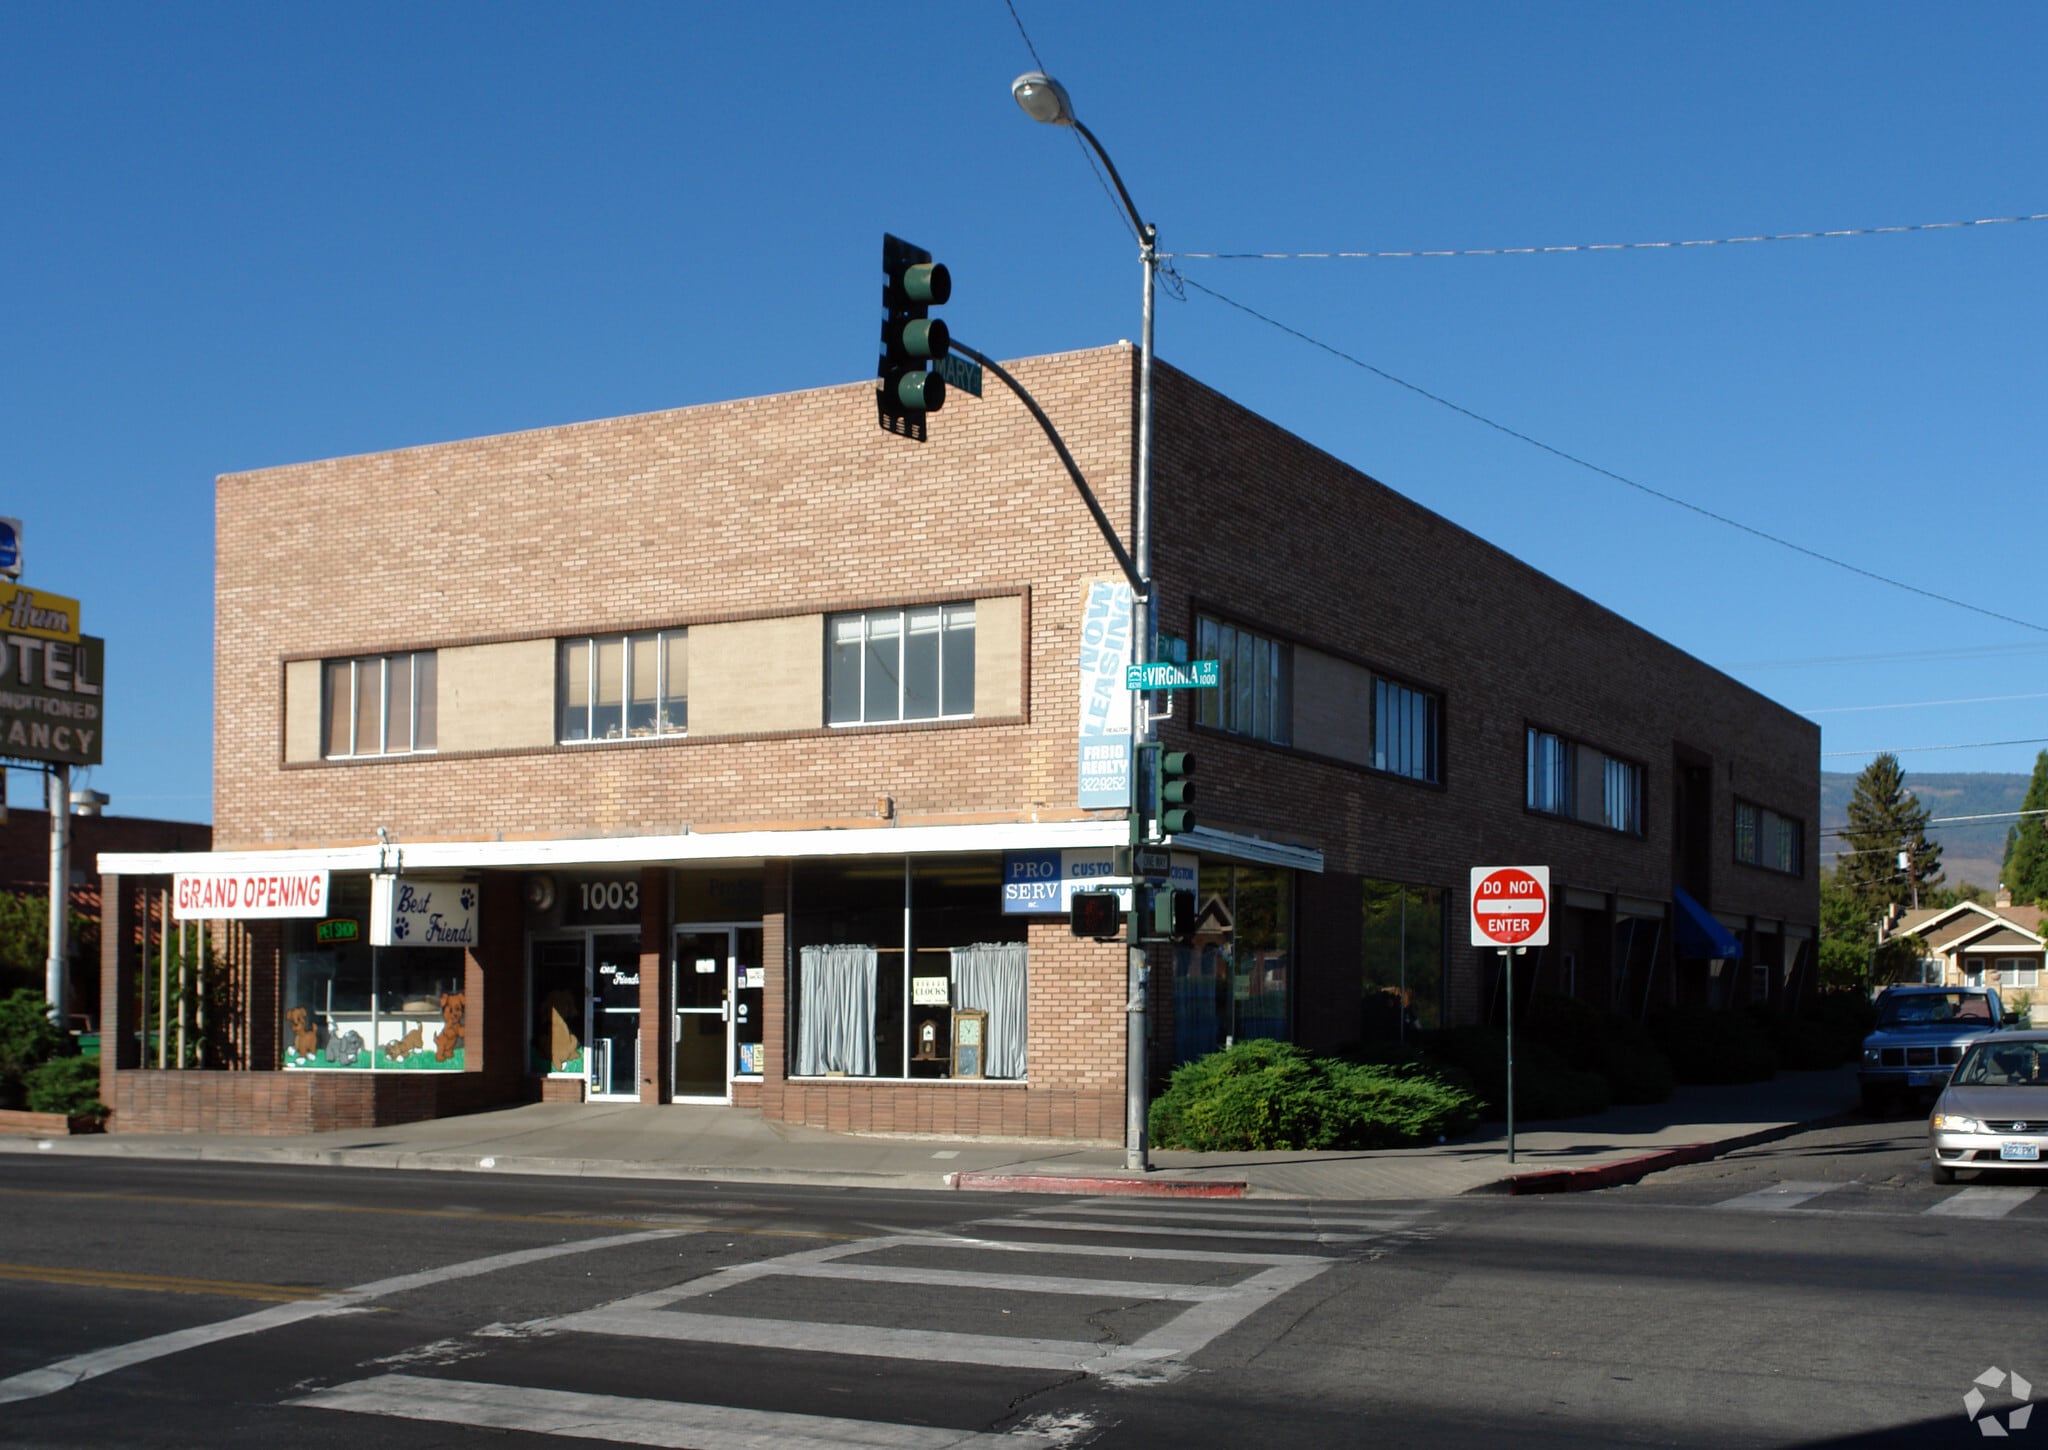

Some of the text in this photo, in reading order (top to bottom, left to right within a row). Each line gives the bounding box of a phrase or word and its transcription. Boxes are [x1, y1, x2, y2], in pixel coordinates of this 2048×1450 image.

[935, 355, 975, 392] MARY
[1080, 582, 1113, 672] NOW
[0, 634, 101, 696] TEL
[1084, 586, 1131, 736] LEASING
[1147, 664, 1199, 686] VIRGINIA
[1203, 662, 1212, 673] ST
[1200, 674, 1216, 685] 1000
[0, 719, 95, 755] ANCY
[1084, 744, 1124, 761] FABIO
[1082, 760, 1128, 775] REALTY
[1011, 861, 1054, 878] PRO
[1072, 863, 1114, 876] CUSTO
[179, 875, 321, 909] GRAND OPENING
[580, 881, 639, 910] 1003
[1006, 882, 1058, 899] SERV
[1483, 880, 1536, 895] DO NOT
[398, 885, 431, 913] Best
[335, 921, 356, 938] SHOP
[426, 914, 472, 943] Friends
[1488, 918, 1530, 932] ENTER
[915, 987, 946, 996] CLOCKS
